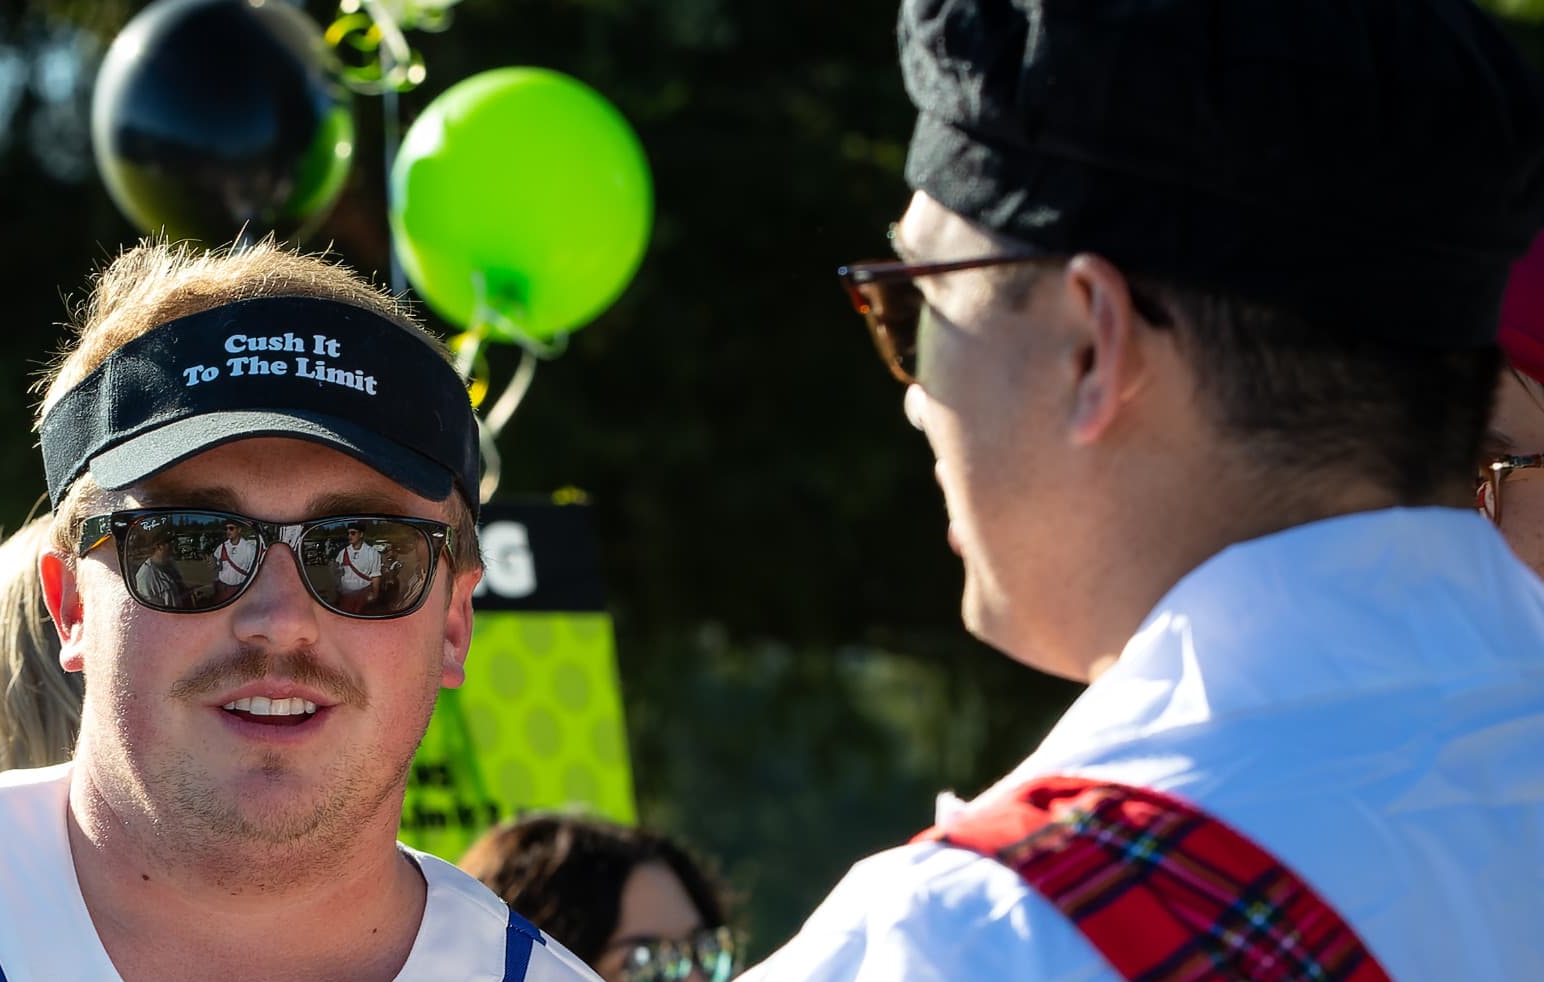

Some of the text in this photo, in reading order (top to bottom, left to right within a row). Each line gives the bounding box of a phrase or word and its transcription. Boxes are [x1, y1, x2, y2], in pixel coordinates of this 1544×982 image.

[225, 332, 341, 358] Cush It
[183, 356, 377, 396] To The Limit
